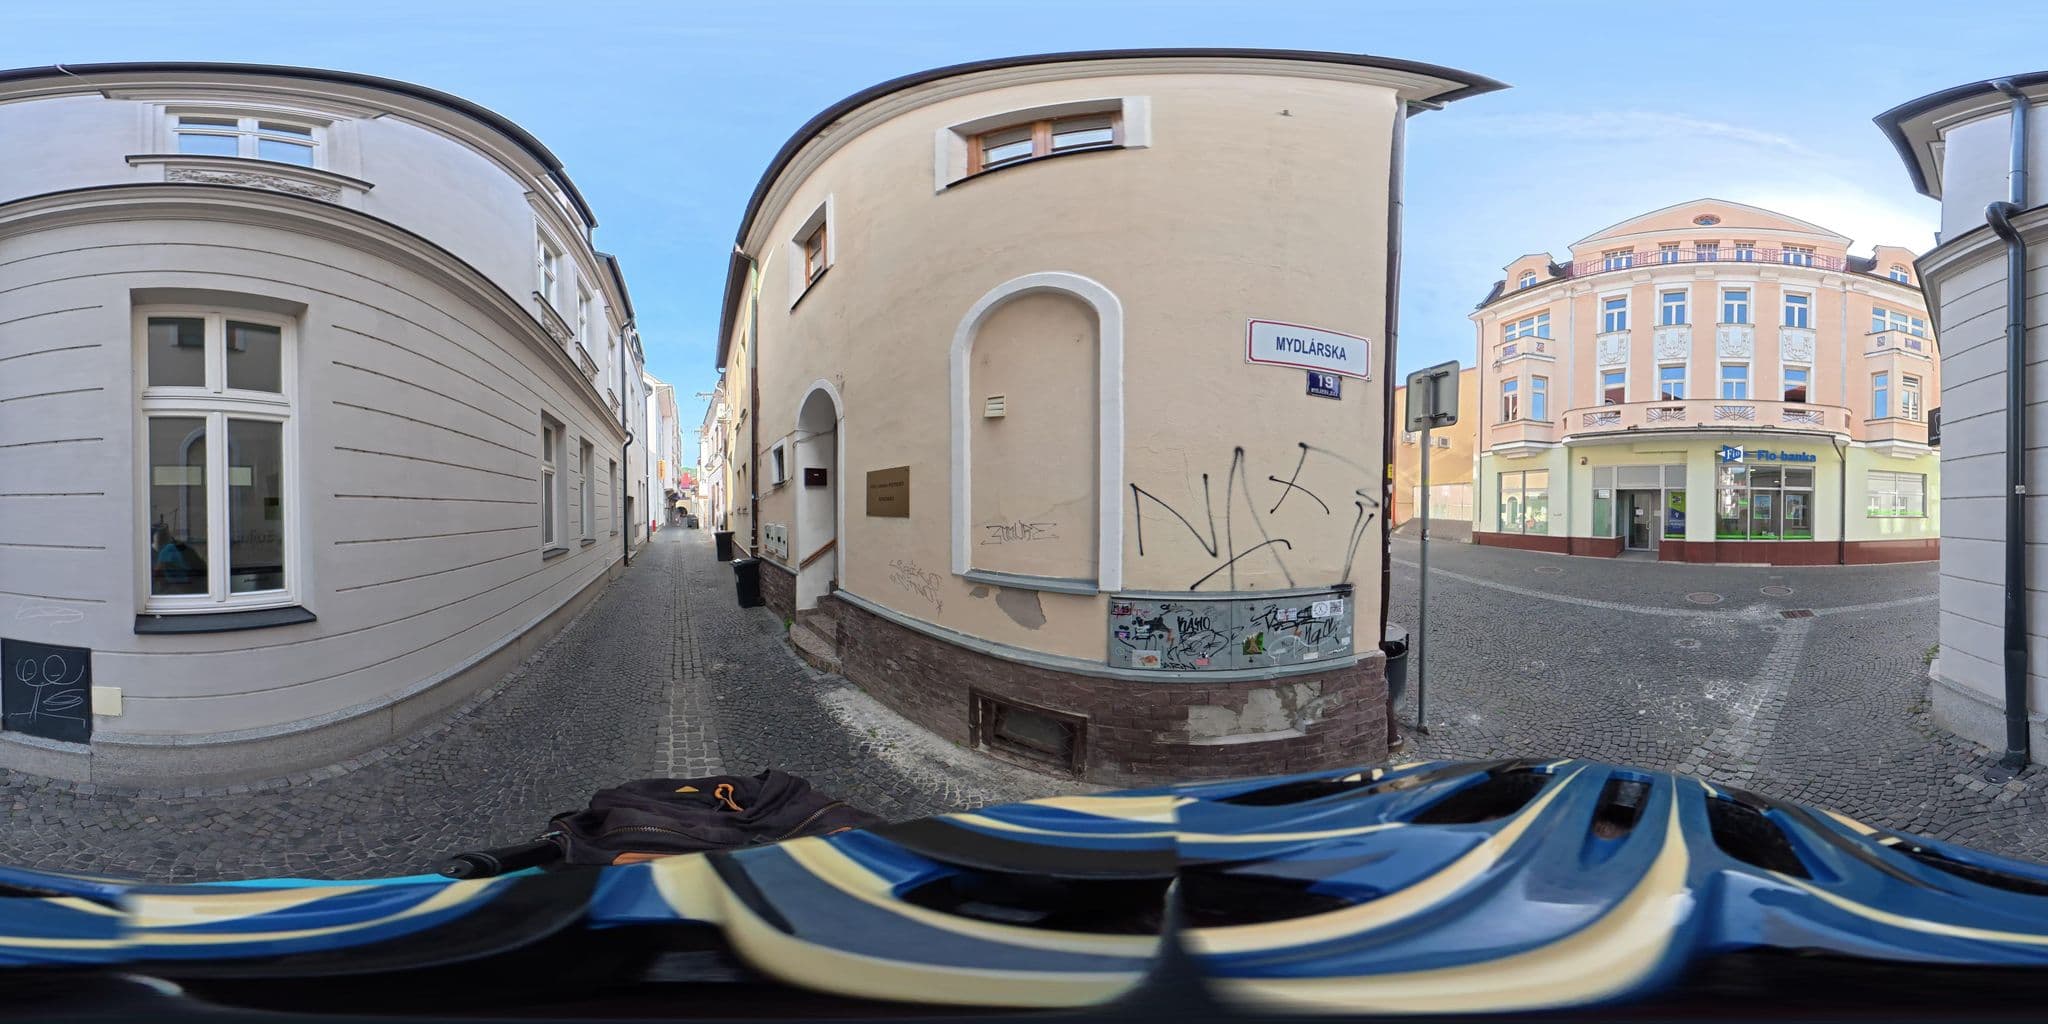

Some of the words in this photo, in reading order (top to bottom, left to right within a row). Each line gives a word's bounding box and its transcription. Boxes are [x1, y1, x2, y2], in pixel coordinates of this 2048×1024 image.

[1276, 336, 1347, 361] MYDLÁRSKA
[1318, 375, 1334, 389] 19
[1757, 449, 1777, 461] Fio
[1780, 451, 1816, 463] banka
